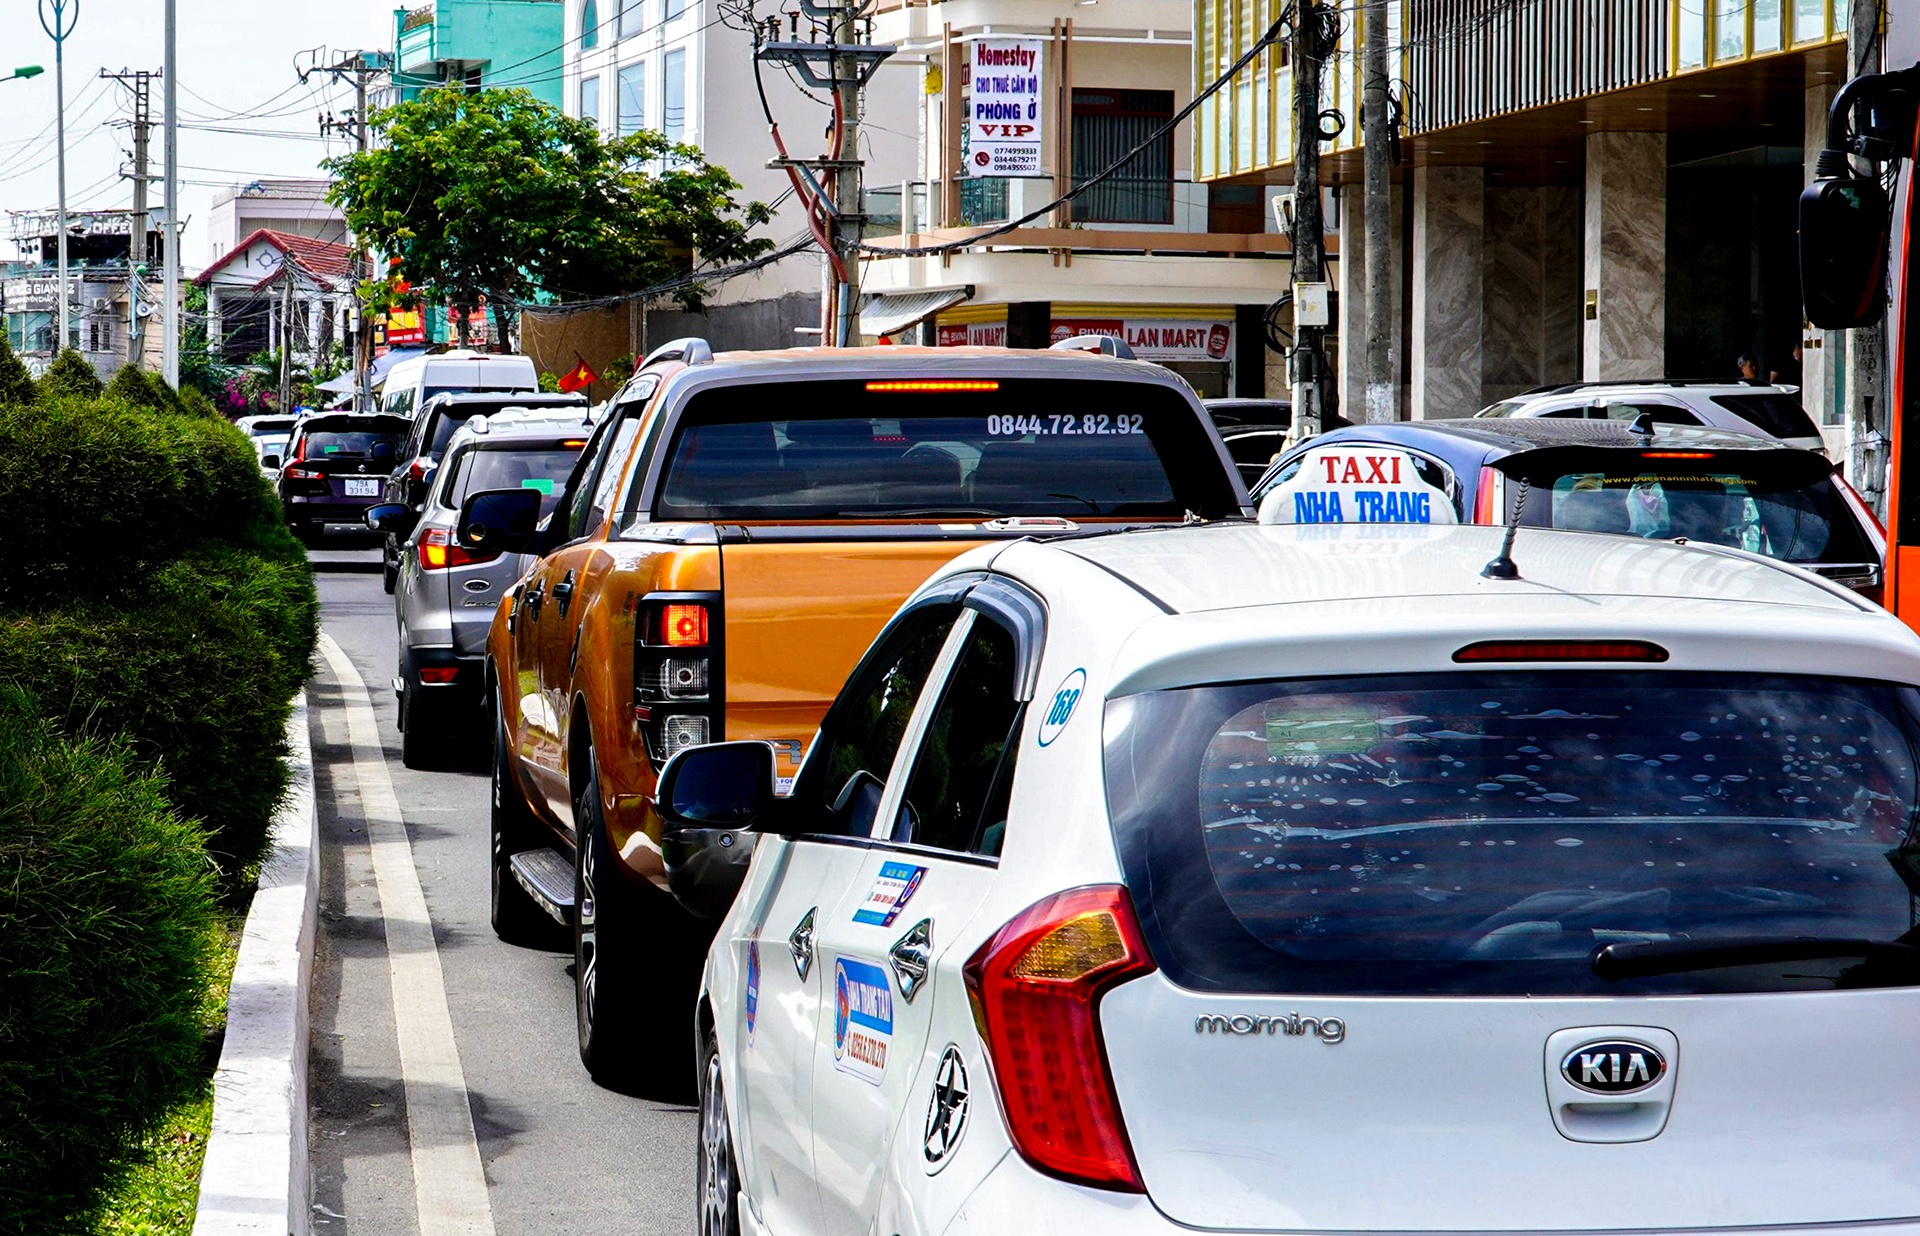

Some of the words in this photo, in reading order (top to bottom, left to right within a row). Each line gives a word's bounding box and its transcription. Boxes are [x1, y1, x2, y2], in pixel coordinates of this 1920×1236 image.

[977, 43, 1036, 73] Homestay
[976, 77, 990, 93] CHO
[992, 74, 1009, 93] THUÊ
[1011, 75, 1025, 93] CĂN
[1028, 75, 1037, 97] HỘ
[976, 100, 1021, 120] PHÒNG
[1028, 98, 1037, 119] Ở
[979, 124, 1034, 137] VIP
[68, 283, 75, 295] 2
[1127, 328, 1160, 348] LAN
[1162, 328, 1206, 348] MART
[987, 414, 1144, 435] 0844.72.82.92
[1320, 456, 1402, 484] TAXI
[1293, 491, 1343, 524] NHA
[1354, 491, 1430, 524] TRANG
[1045, 688, 1080, 726] 168
[1195, 1010, 1347, 1046] morning
[1578, 1052, 1651, 1084] KIA
